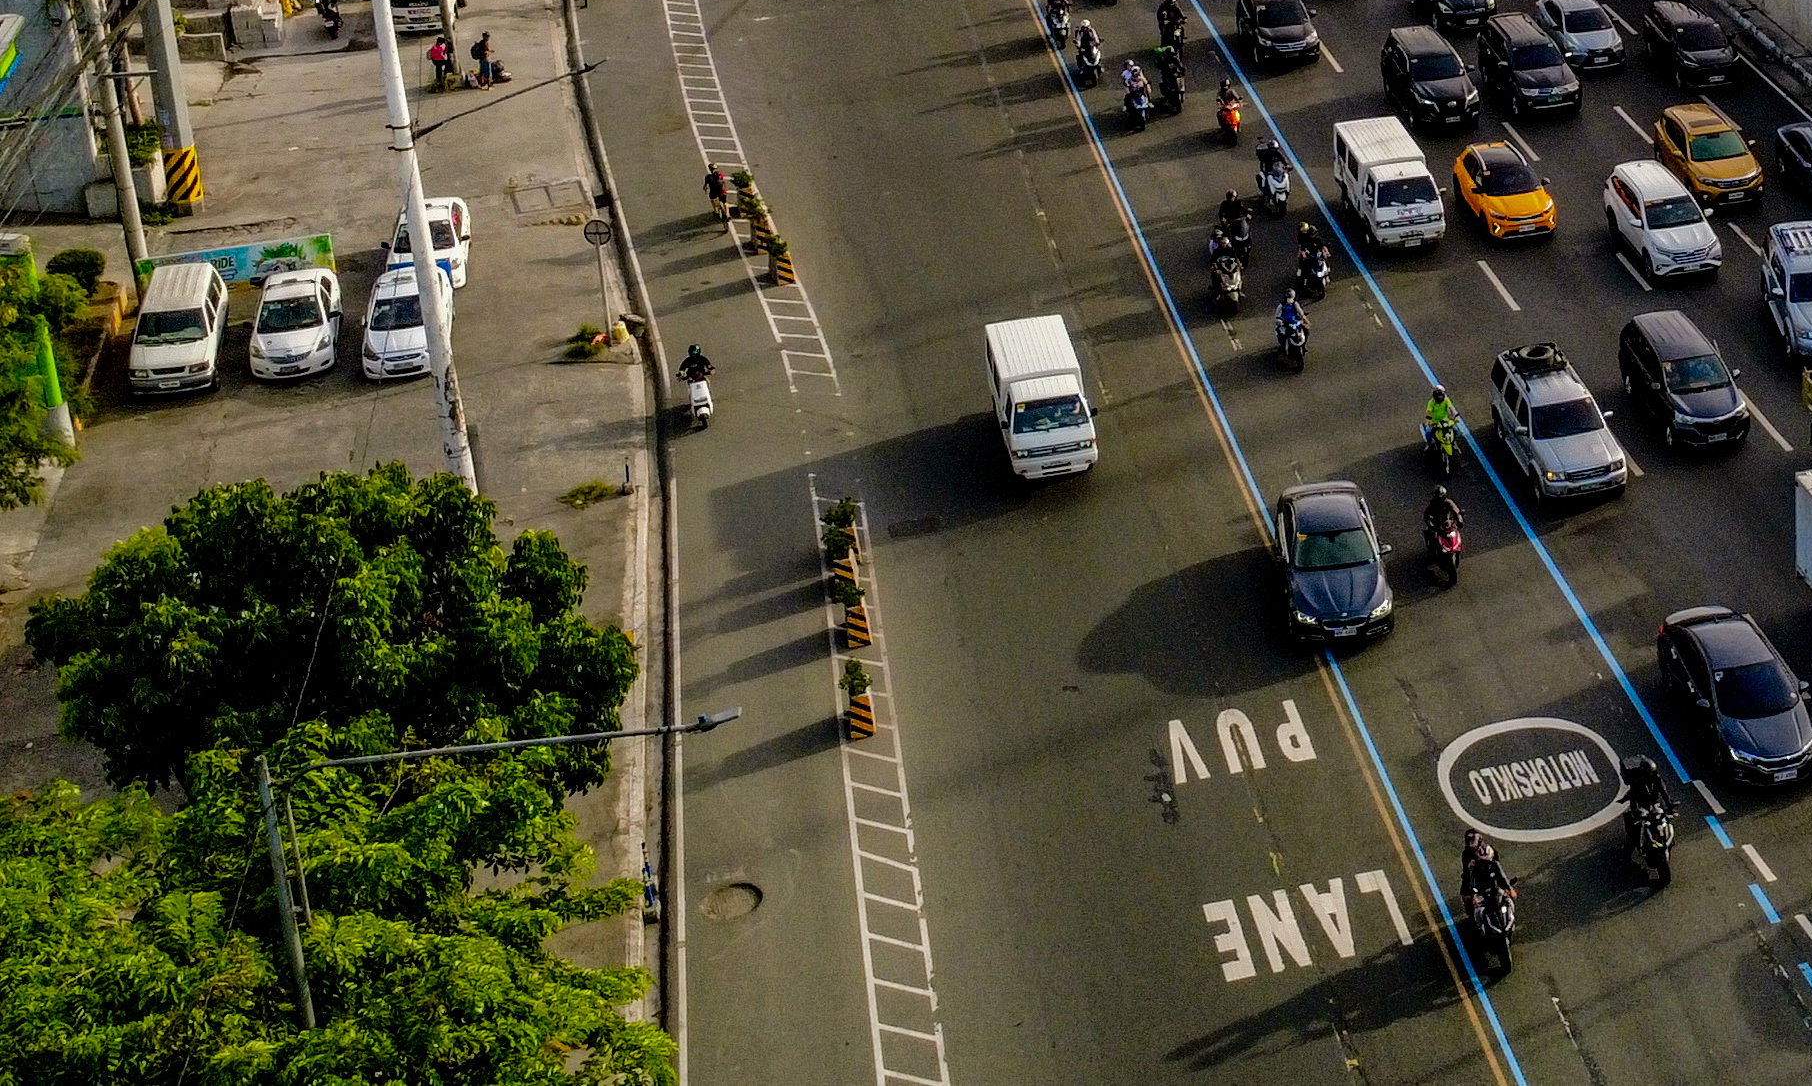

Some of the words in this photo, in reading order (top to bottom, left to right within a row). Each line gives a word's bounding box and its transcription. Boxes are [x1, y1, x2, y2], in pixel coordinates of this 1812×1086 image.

[1168, 698, 1318, 785] PUV
[1468, 749, 1600, 806] MOTORSIKLO
[1202, 869, 1414, 983] LANE
